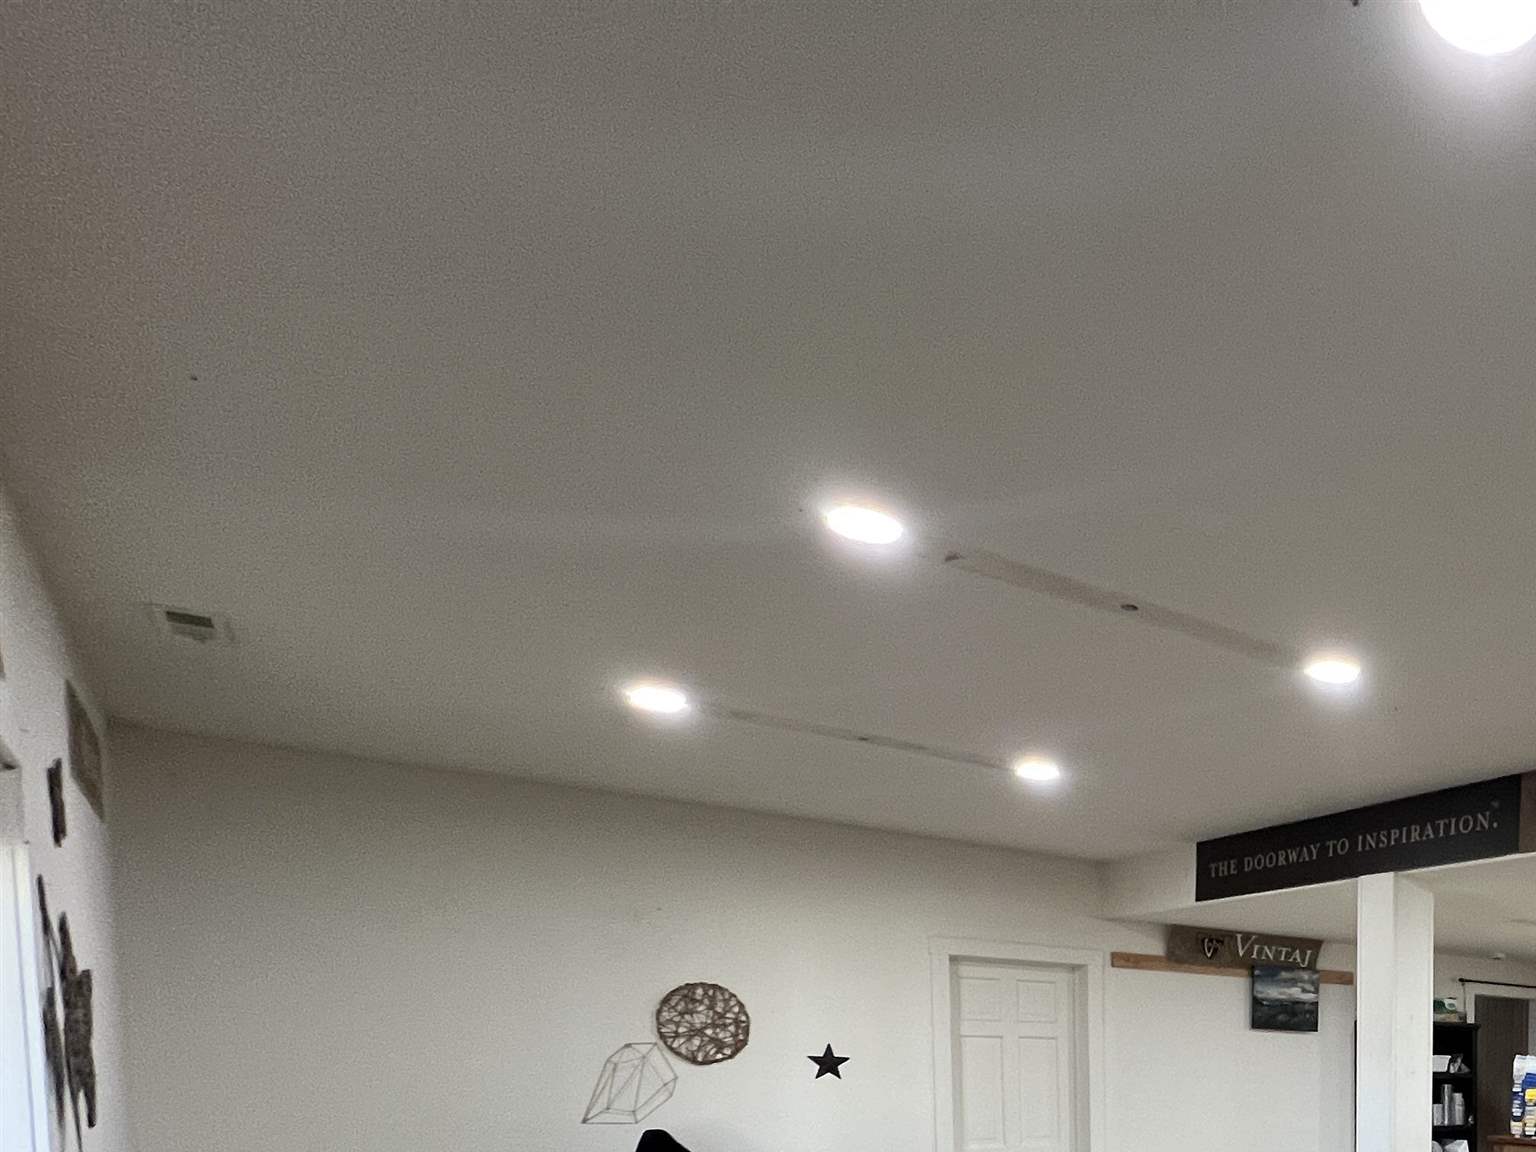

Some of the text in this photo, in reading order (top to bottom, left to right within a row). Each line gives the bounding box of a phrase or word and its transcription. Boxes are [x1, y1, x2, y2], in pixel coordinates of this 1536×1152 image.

[1209, 860, 1239, 879] THE
[1244, 842, 1321, 873] DOORWAY
[1326, 838, 1350, 858] TO
[1235, 932, 1313, 968] VINTAJ
